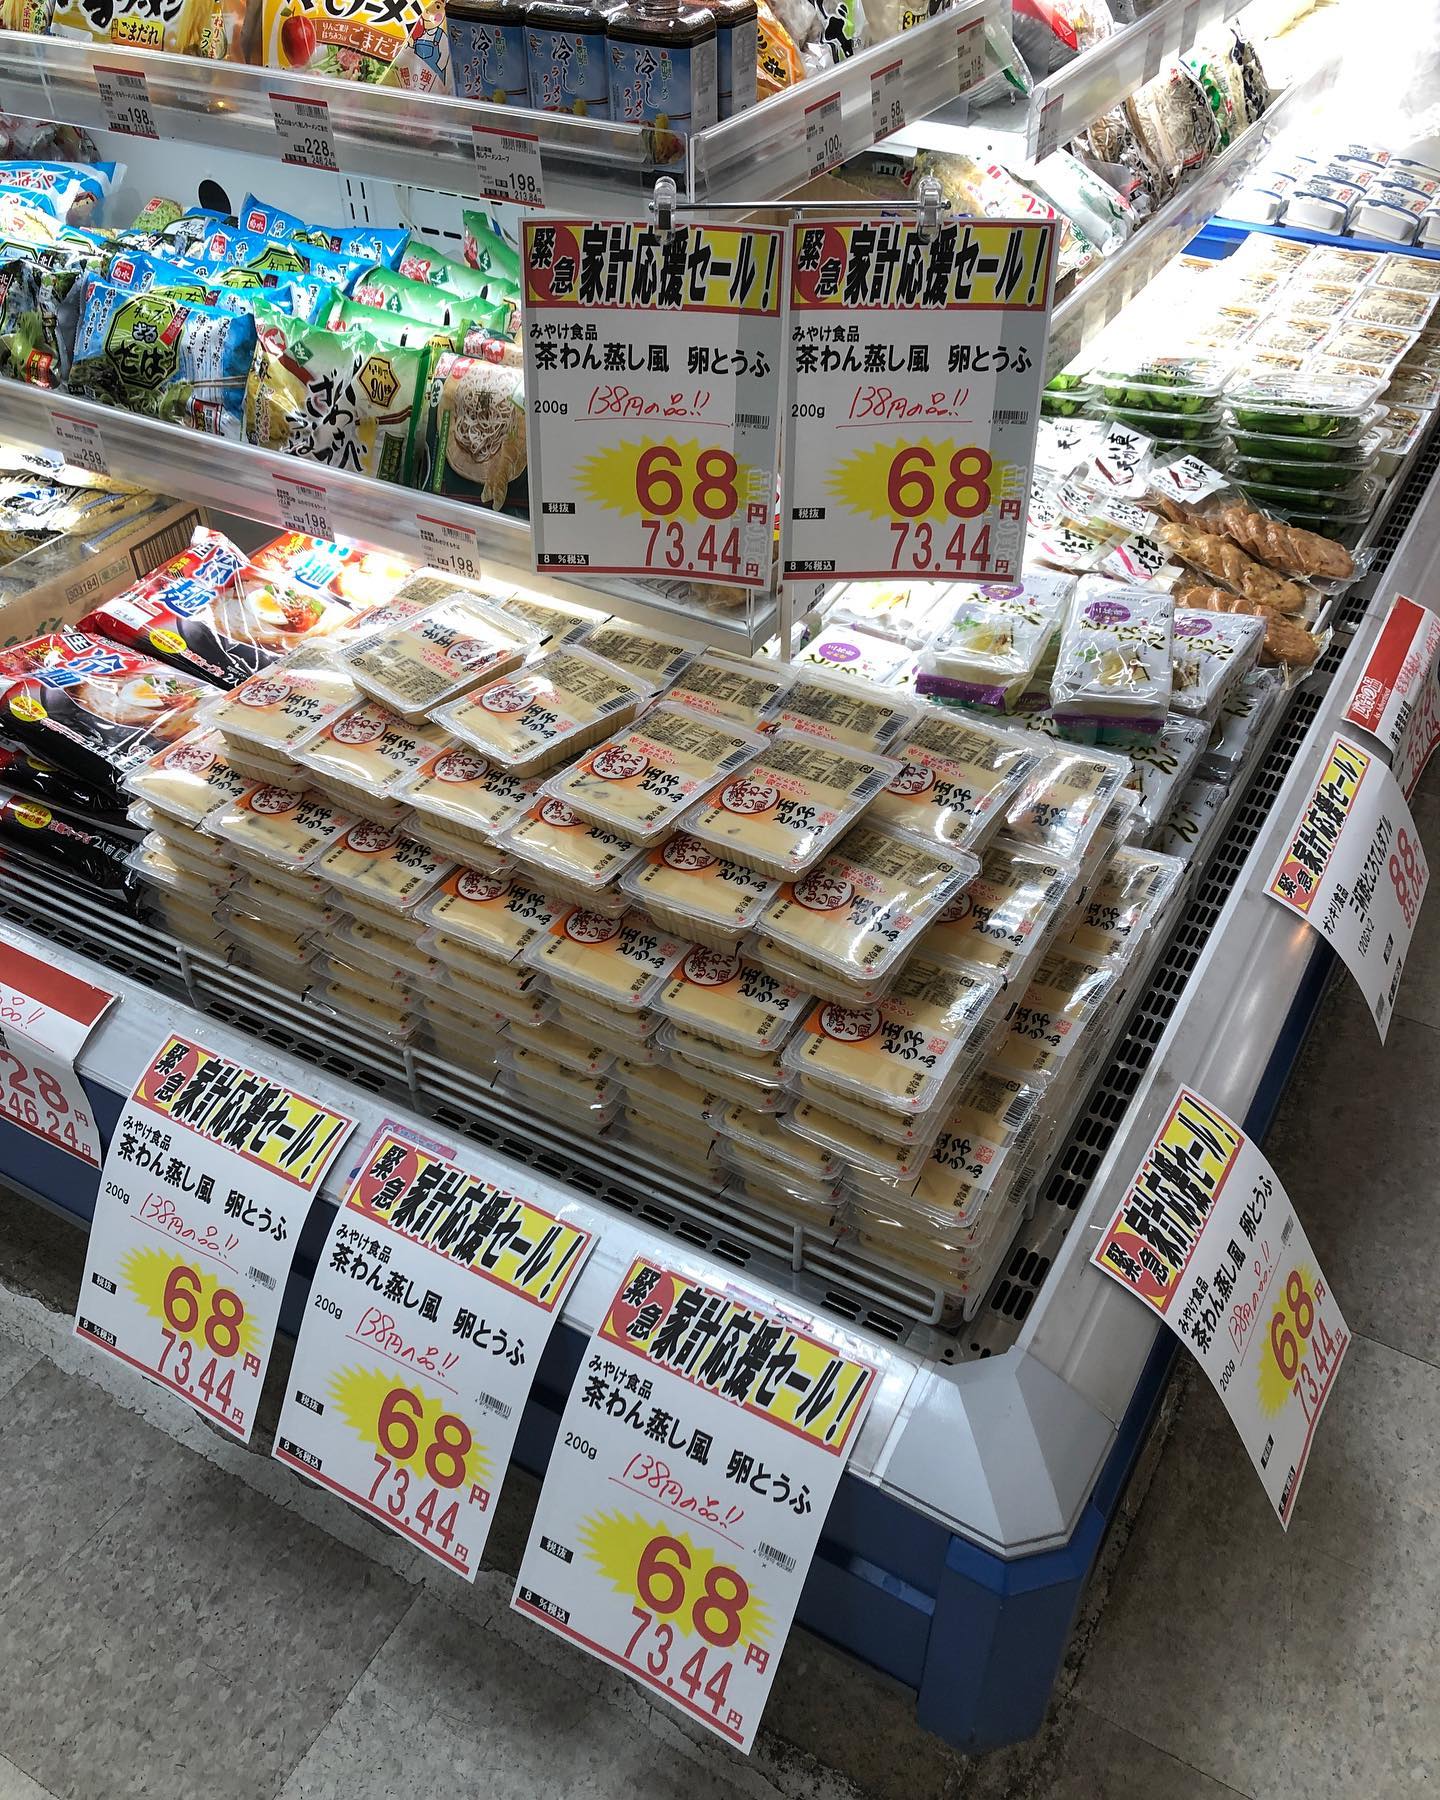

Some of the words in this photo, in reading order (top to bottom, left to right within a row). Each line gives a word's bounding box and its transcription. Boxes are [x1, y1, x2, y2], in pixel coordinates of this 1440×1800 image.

[118, 21, 159, 45] ごまだれ
[471, 27, 496, 84] 冷し
[552, 35, 576, 95] 冷し
[464, 64, 472, 93] スープ
[472, 57, 482, 95] ラーメン
[544, 74, 552, 103] スープ
[552, 66, 561, 103] ラーメン
[634, 48, 659, 109] 冷し
[624, 88, 633, 118] スープ
[634, 80, 644, 118] ラーメン
[531, 228, 575, 293] 緊急
[798, 229, 841, 296] 緊急
[132, 320, 158, 344] ざる
[530, 324, 597, 340] みやけ食品
[792, 325, 860, 342] みやけ食品
[114, 340, 175, 381] そば
[534, 342, 669, 372] 茶わん蒸し風
[688, 346, 770, 377] 卵とうふ
[796, 344, 930, 373] 茶わん蒸し風
[948, 345, 1032, 373] 卵とうふ
[534, 400, 568, 415] 200g
[792, 404, 826, 418] 200g
[548, 503, 569, 513] 税抜
[798, 509, 820, 519] 税抜
[1277, 870, 1314, 898] 緊急
[154, 1044, 190, 1102] 緊急
[122, 1116, 172, 1151] みやけ食品
[105, 1182, 130, 1205] 200g
[117, 1134, 216, 1204] 茶わん蒸し風
[224, 1190, 288, 1242] 卵とうふ
[370, 1144, 408, 1211] 緊急
[336, 1224, 392, 1264] みやけ食品
[1105, 1240, 1170, 1286] 緊急
[1190, 1238, 1246, 1355] 茶わん蒸し風
[1238, 1175, 1273, 1242] 卵とうふ
[96, 1274, 112, 1290] 税抜
[314, 1294, 344, 1320] 200g
[329, 1243, 442, 1323] 茶わん蒸し風
[452, 1307, 526, 1366] 卵とうふ
[621, 1266, 662, 1340] 緊急
[1177, 1277, 1209, 1334] みやけ食品
[588, 1354, 654, 1400] みやけ食品
[1220, 1360, 1236, 1392] 200g
[300, 1394, 318, 1412] 税抜
[564, 1432, 598, 1460] 200g
[581, 1375, 714, 1466] 茶わん蒸し風
[726, 1448, 812, 1516] 卵とうふ
[1262, 1438, 1273, 1466] 税抜
[546, 1540, 567, 1560] 税抜
